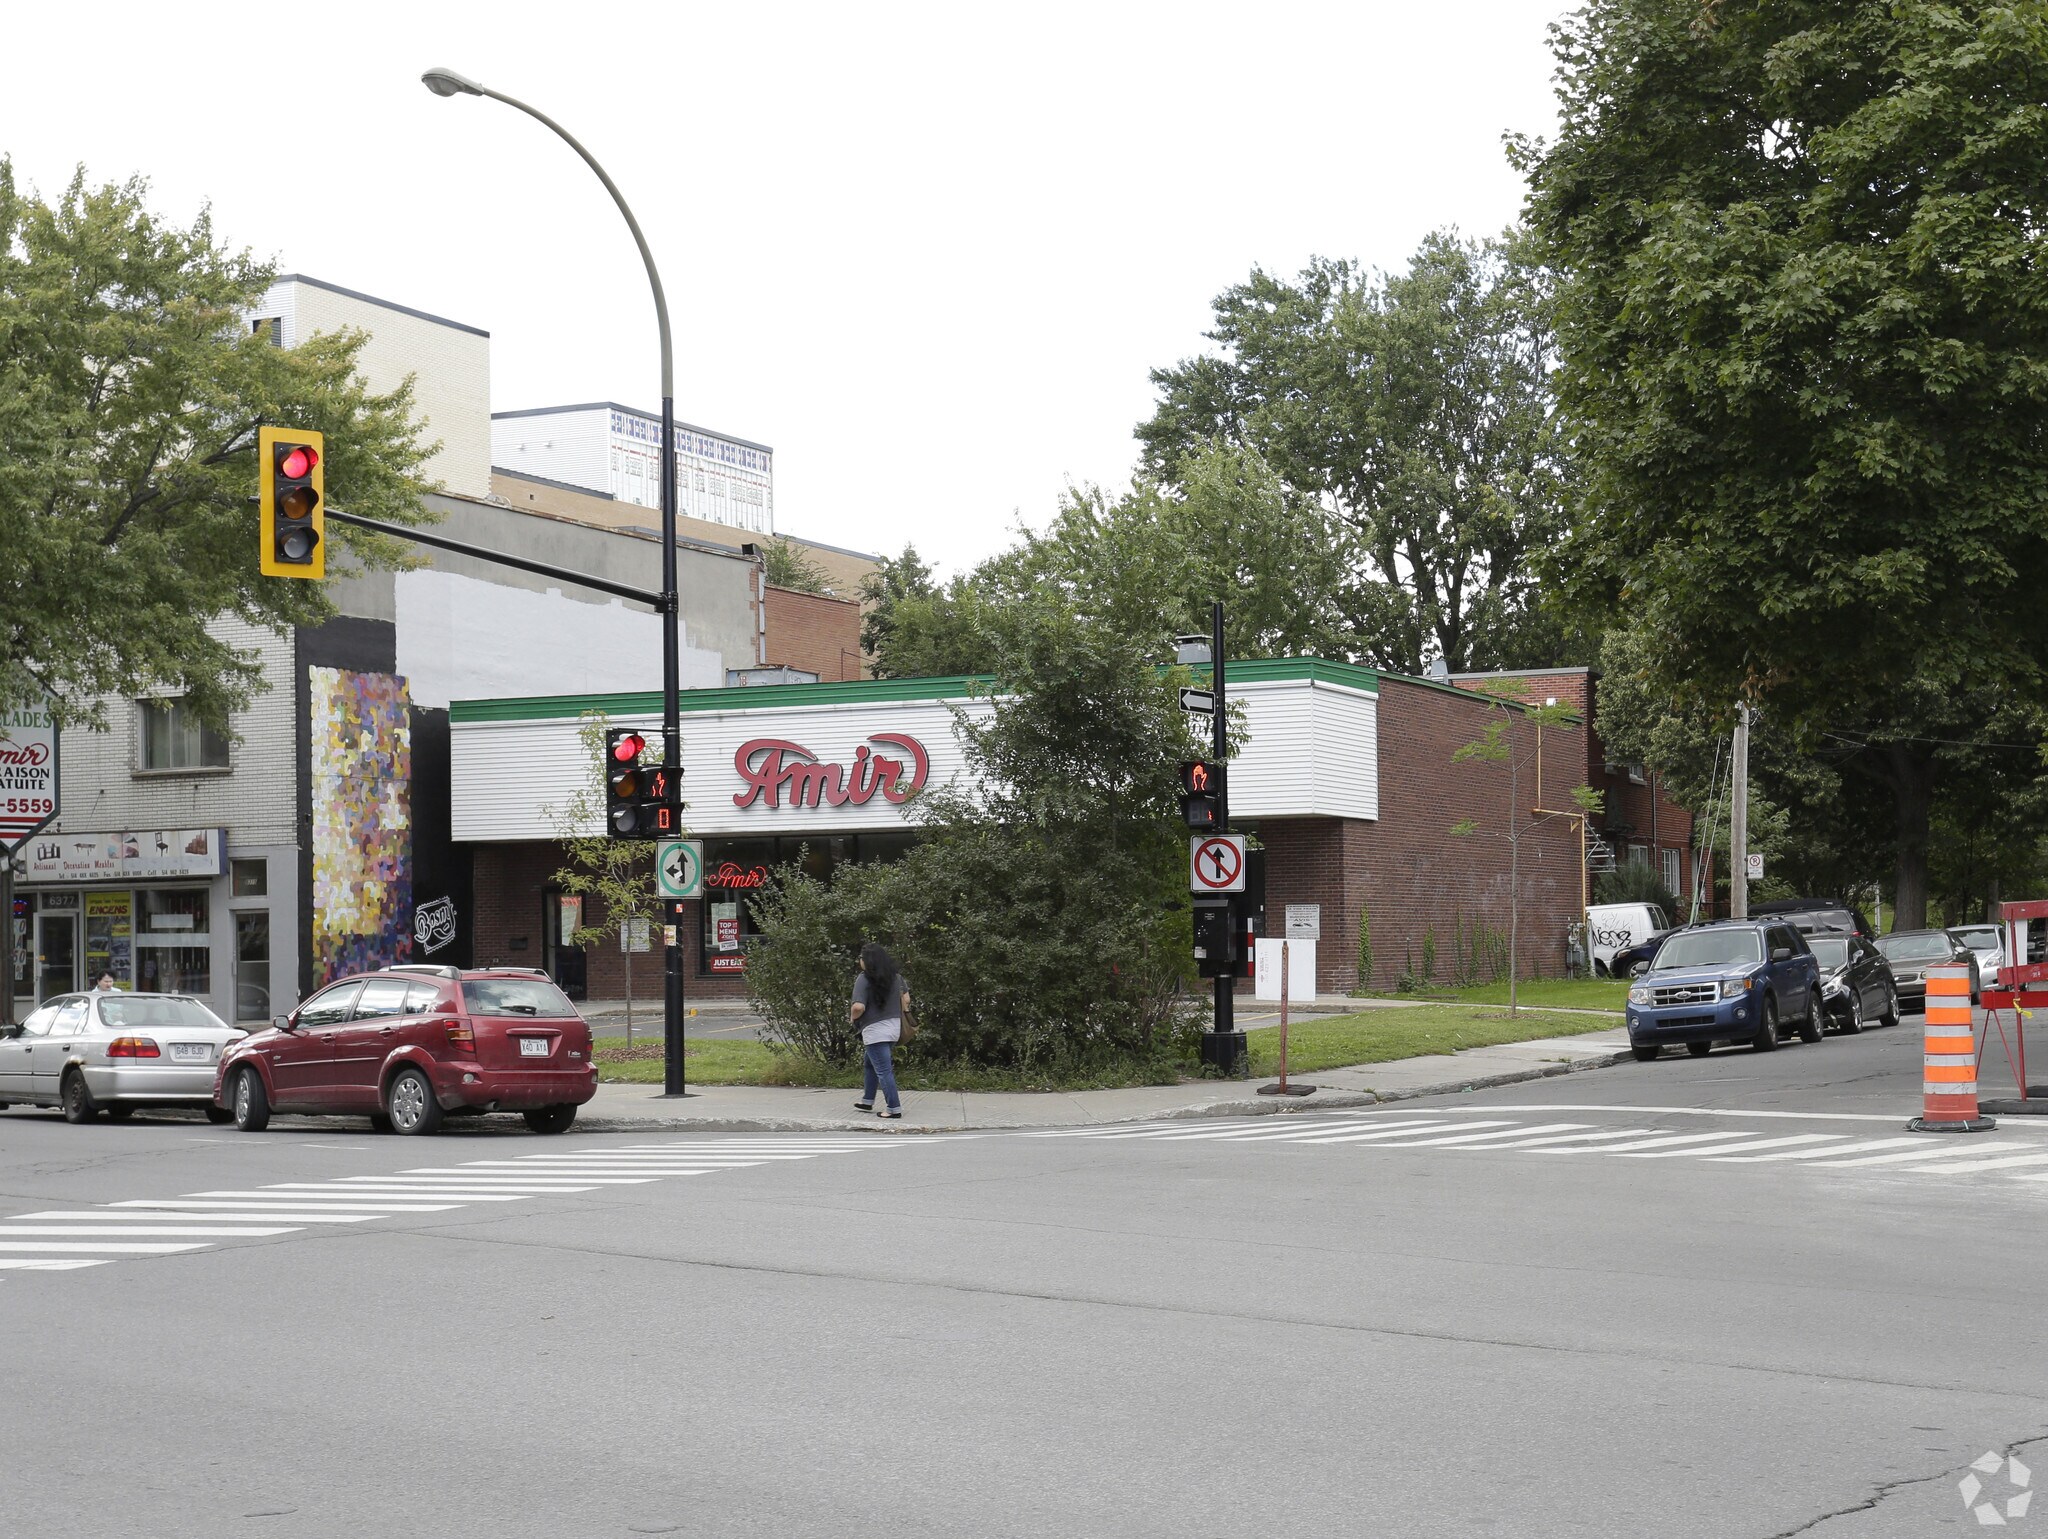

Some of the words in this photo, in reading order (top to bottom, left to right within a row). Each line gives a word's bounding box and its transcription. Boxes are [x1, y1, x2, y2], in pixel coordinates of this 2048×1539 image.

[0, 711, 52, 729] LADES
[733, 733, 929, 808] Amir
[708, 862, 767, 888] Amir
[89, 905, 128, 915] ENCENS
[713, 958, 729, 966] JUST
